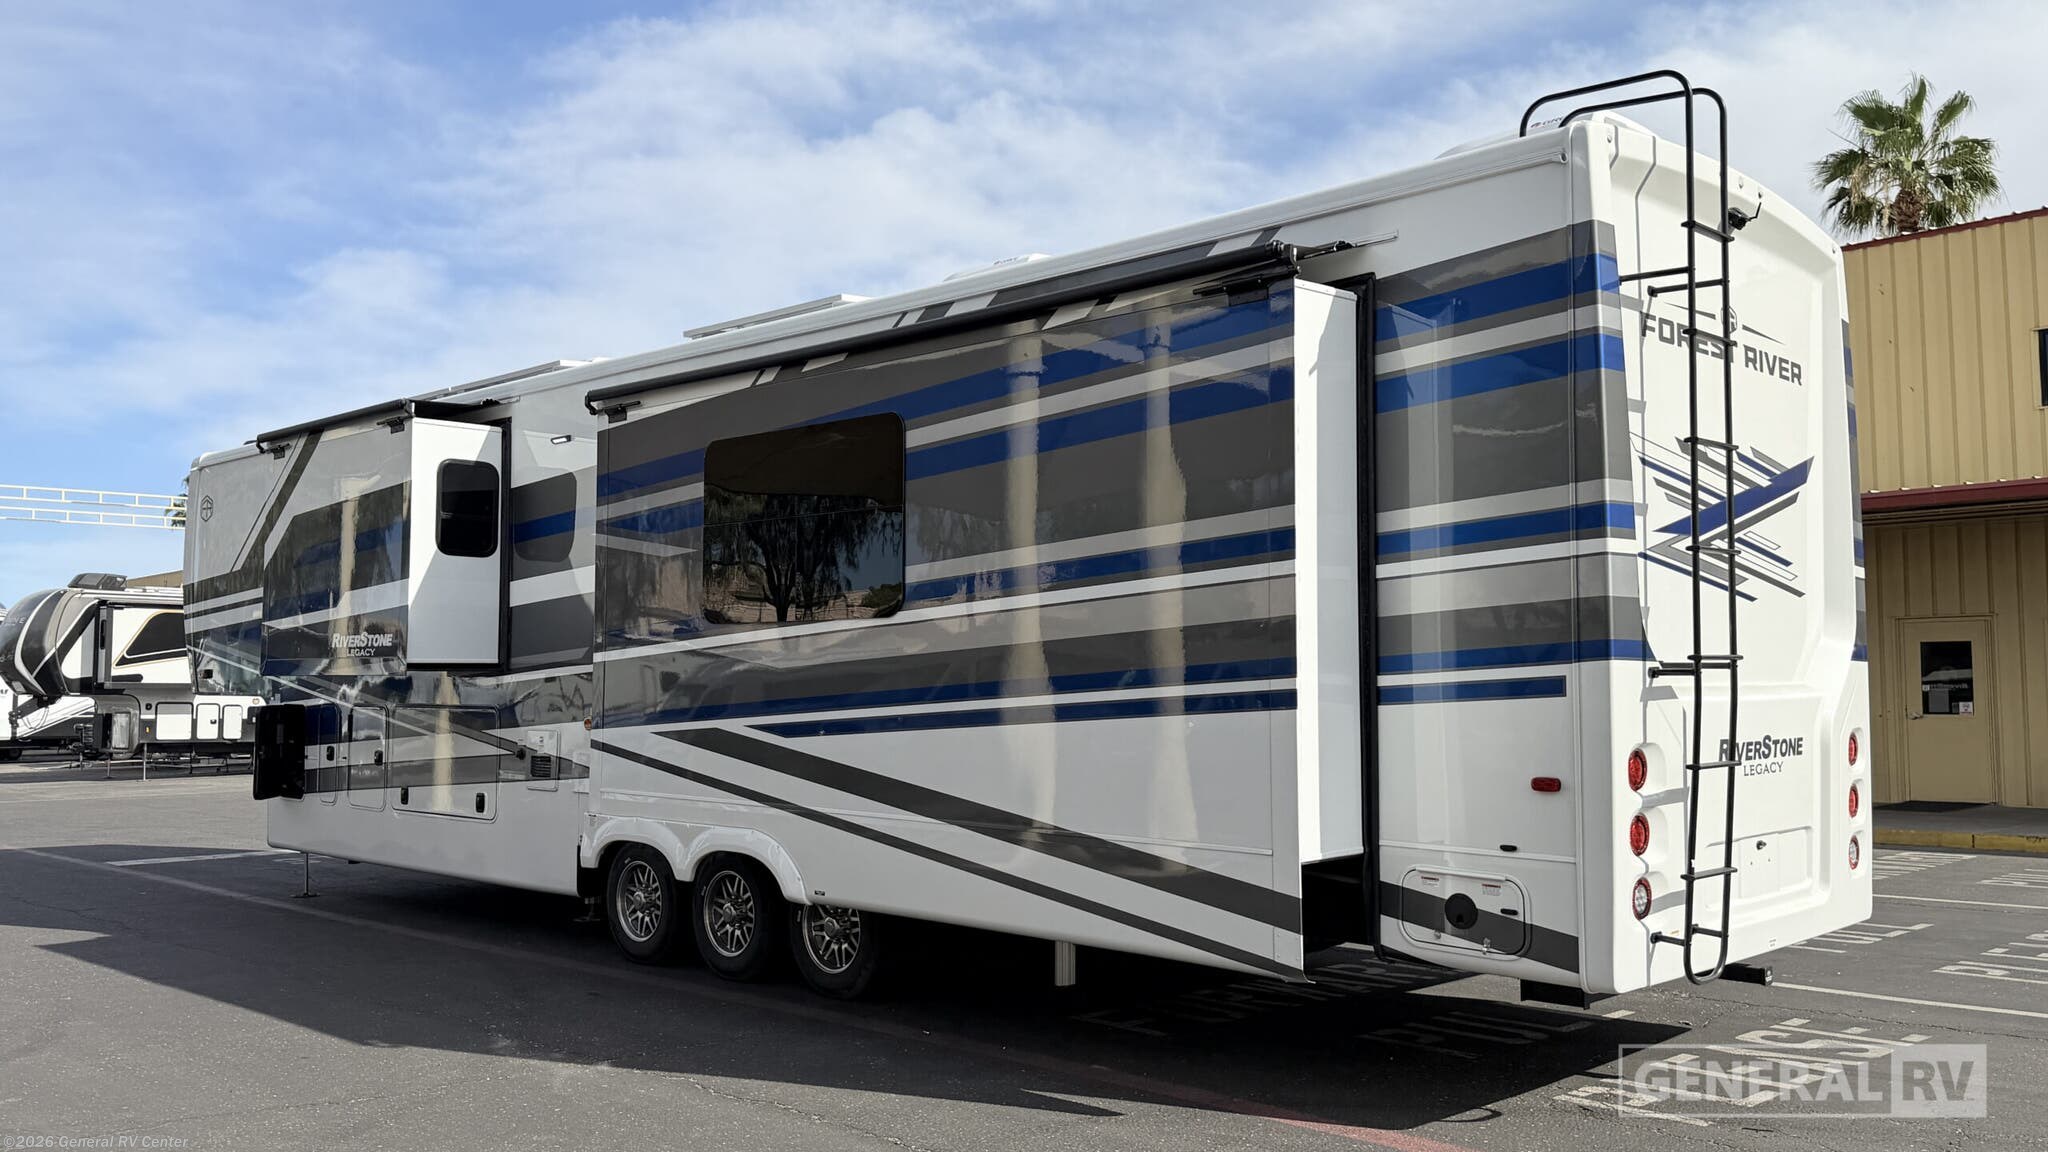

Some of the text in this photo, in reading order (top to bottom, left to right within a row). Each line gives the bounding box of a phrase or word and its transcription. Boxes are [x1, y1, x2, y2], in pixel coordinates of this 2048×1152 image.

[1743, 344, 1802, 386] RIVER
[346, 648, 376, 656] LEGACY
[1719, 734, 1803, 762] RVERSTONE
[1743, 761, 1783, 776] LEGACY
